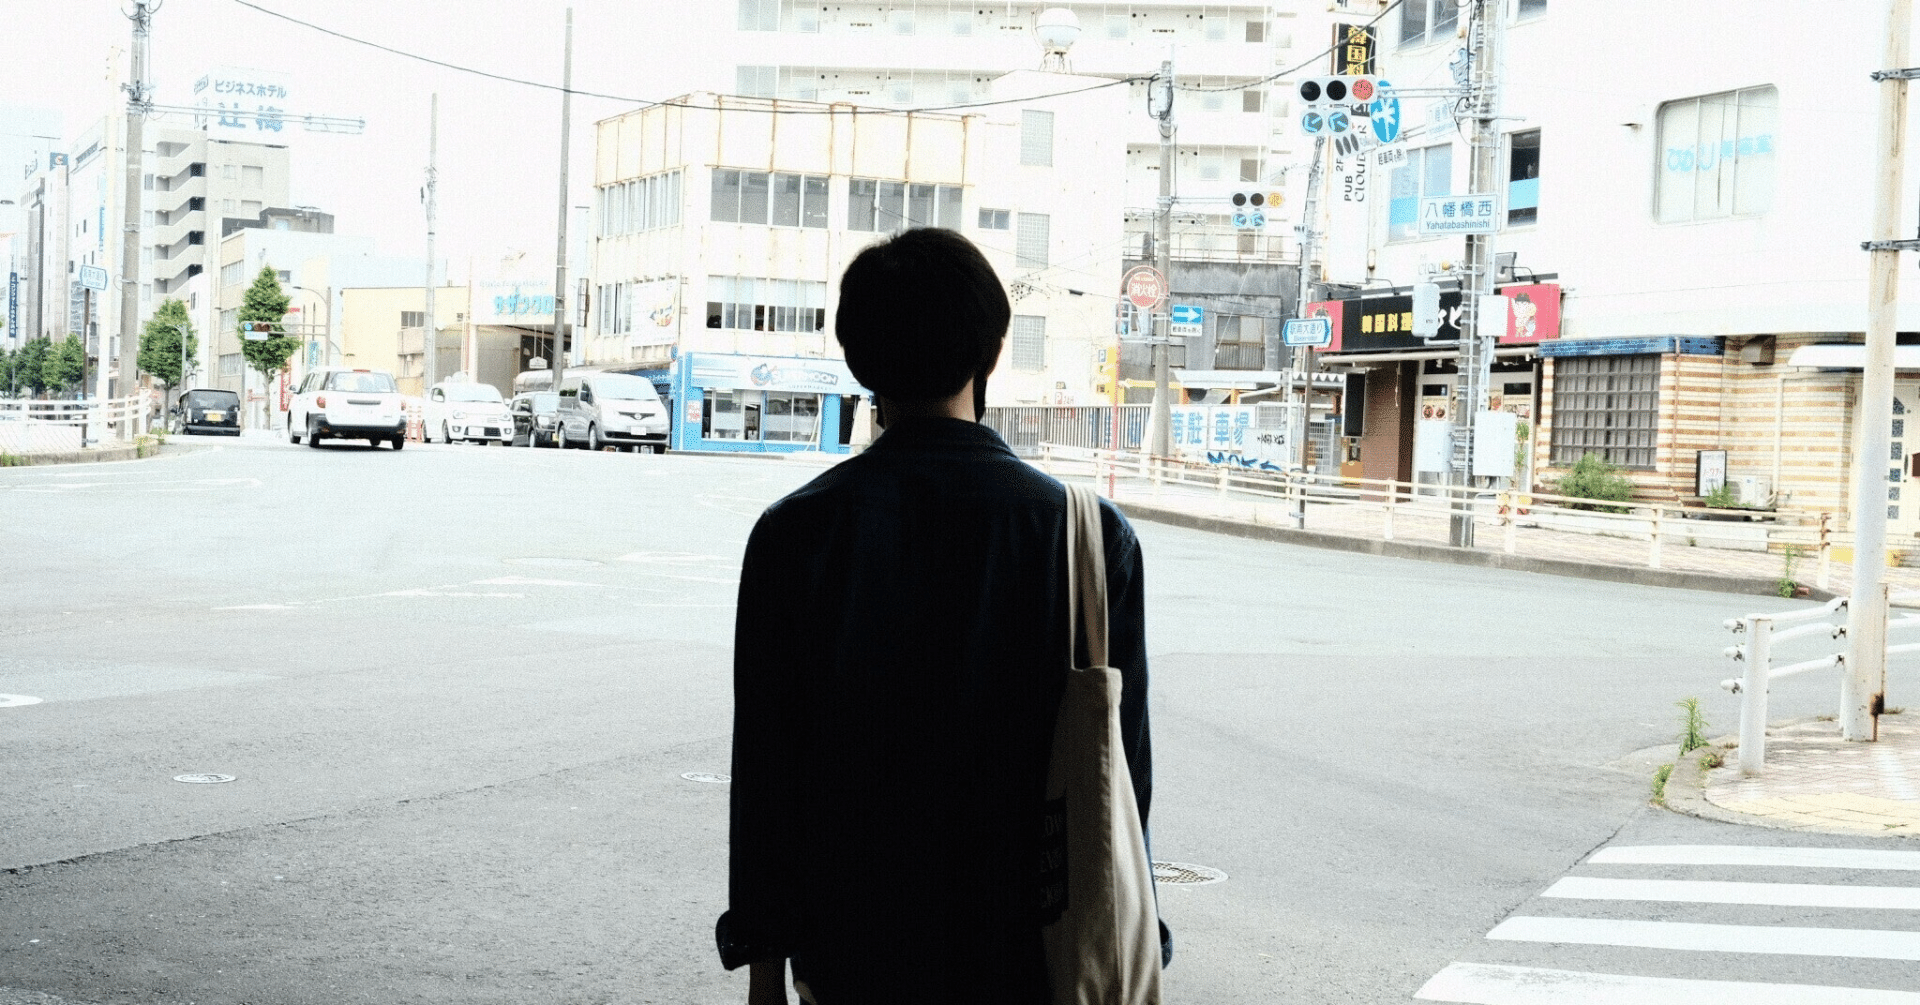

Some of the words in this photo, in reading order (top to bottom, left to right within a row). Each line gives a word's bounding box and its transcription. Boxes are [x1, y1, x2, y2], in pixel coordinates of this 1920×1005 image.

[214, 79, 287, 98] ビジネスホテル
[1344, 175, 1353, 202] PUB
[1425, 200, 1492, 218] 八幡橋西
[1426, 218, 1490, 230] Yahatabashinishi
[1130, 282, 1158, 298] 消火栓
